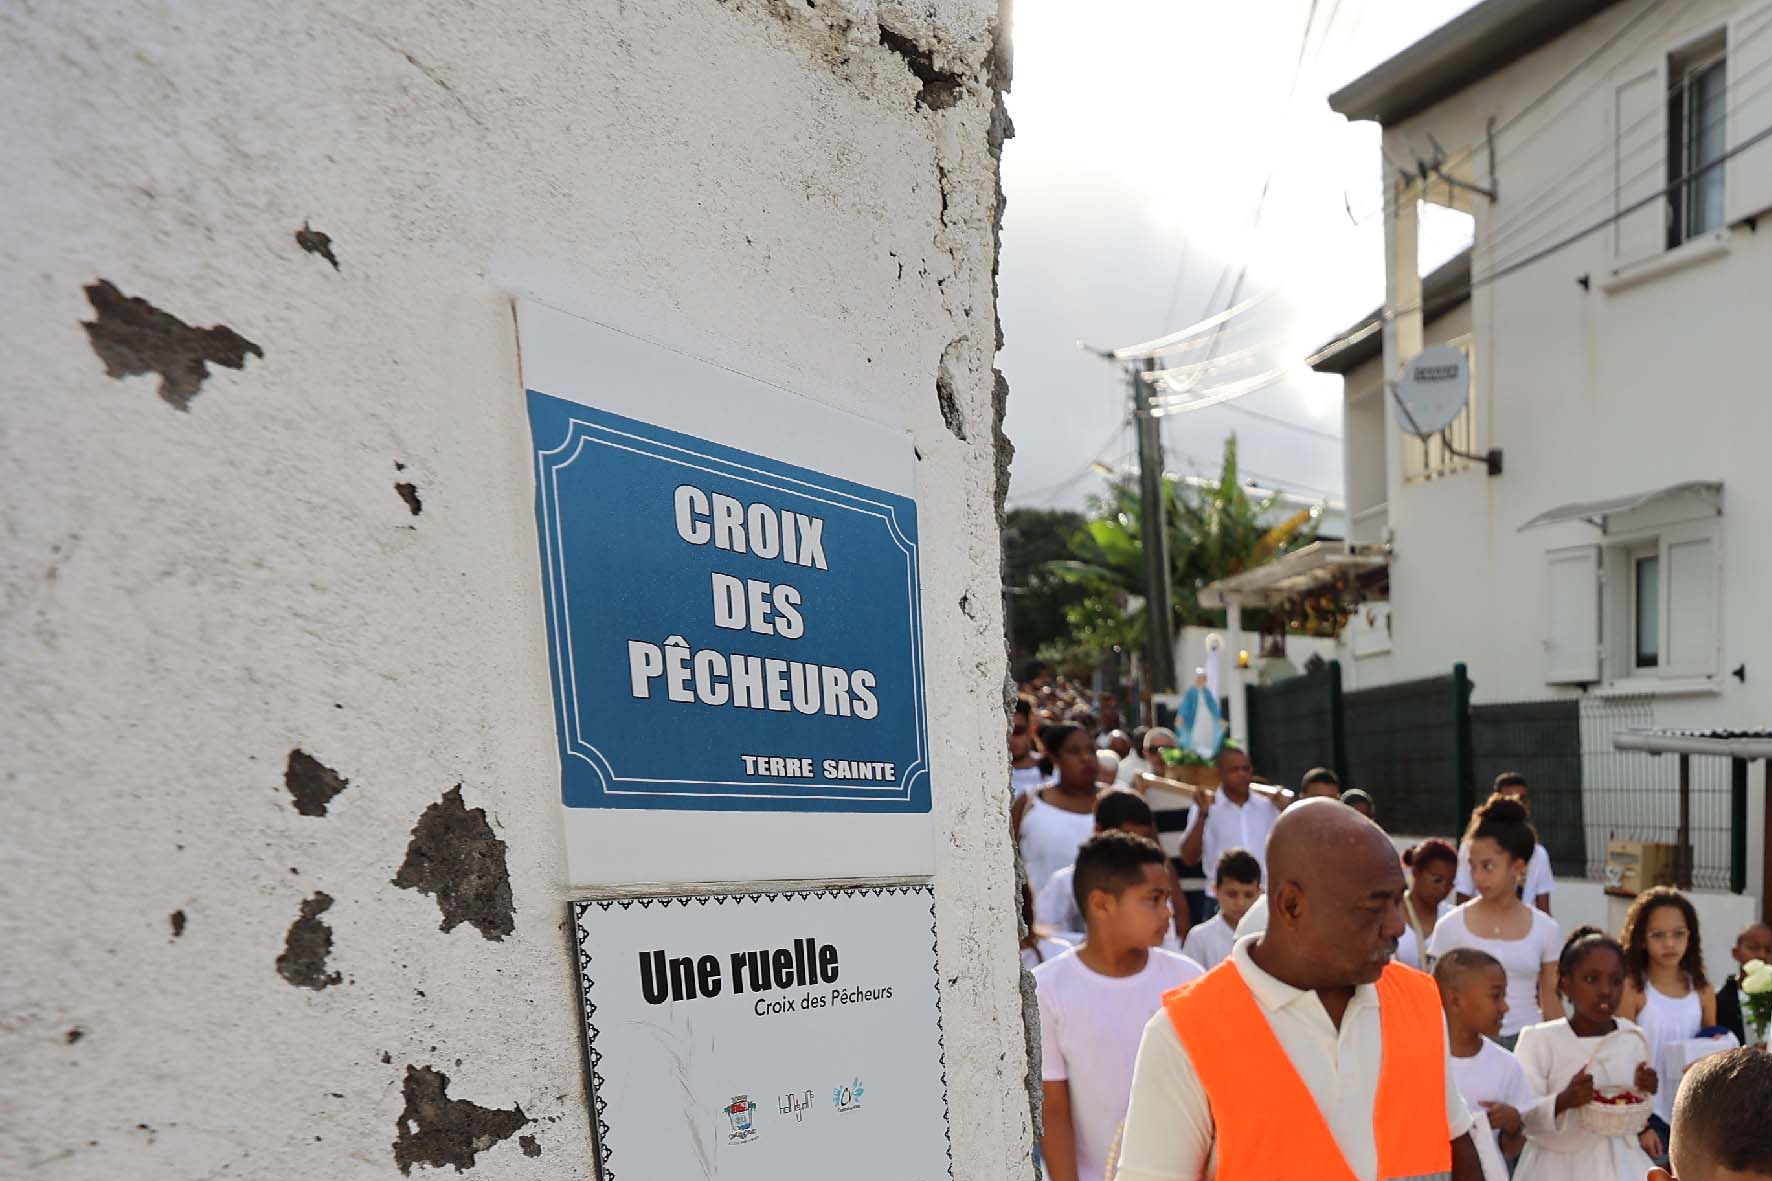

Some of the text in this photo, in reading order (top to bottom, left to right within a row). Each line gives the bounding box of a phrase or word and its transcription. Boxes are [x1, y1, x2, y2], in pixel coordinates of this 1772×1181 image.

[673, 484, 830, 571] CROIX
[711, 572, 805, 640] DES
[627, 634, 880, 720] PÊCHEURS
[741, 755, 897, 782] TERRE SAINTE
[638, 938, 839, 1005] Une ruelle
[754, 985, 893, 1016] Croix des Pêcheurs
